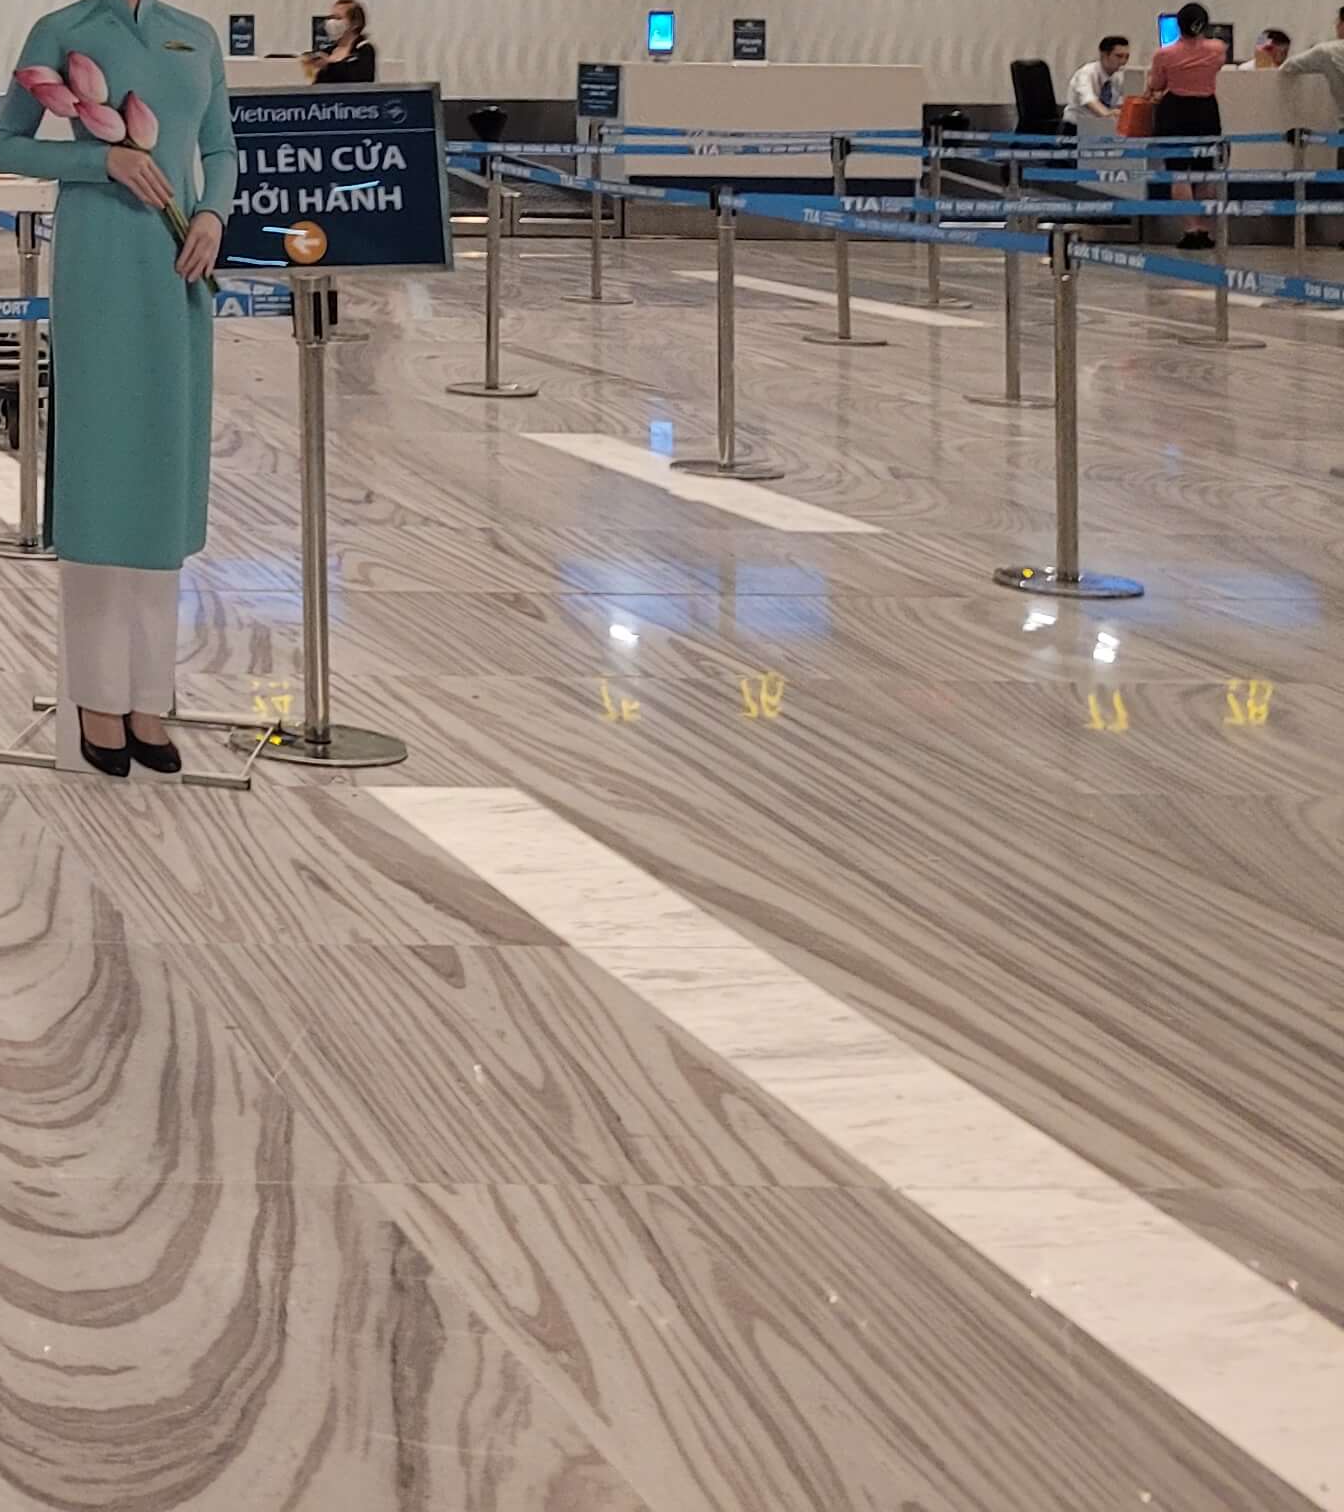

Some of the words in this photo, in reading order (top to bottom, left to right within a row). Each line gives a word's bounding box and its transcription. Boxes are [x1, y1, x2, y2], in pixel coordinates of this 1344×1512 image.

[231, 105, 305, 123] Vietnam
[307, 103, 379, 121] Airlines
[257, 144, 322, 174] LÊN
[331, 139, 407, 171] CỬA
[1097, 170, 1129, 182] TIA
[231, 182, 289, 215] HỞI
[840, 196, 880, 211] TIA
[1202, 201, 1240, 215] TIA
[1225, 268, 1259, 290] TIA
